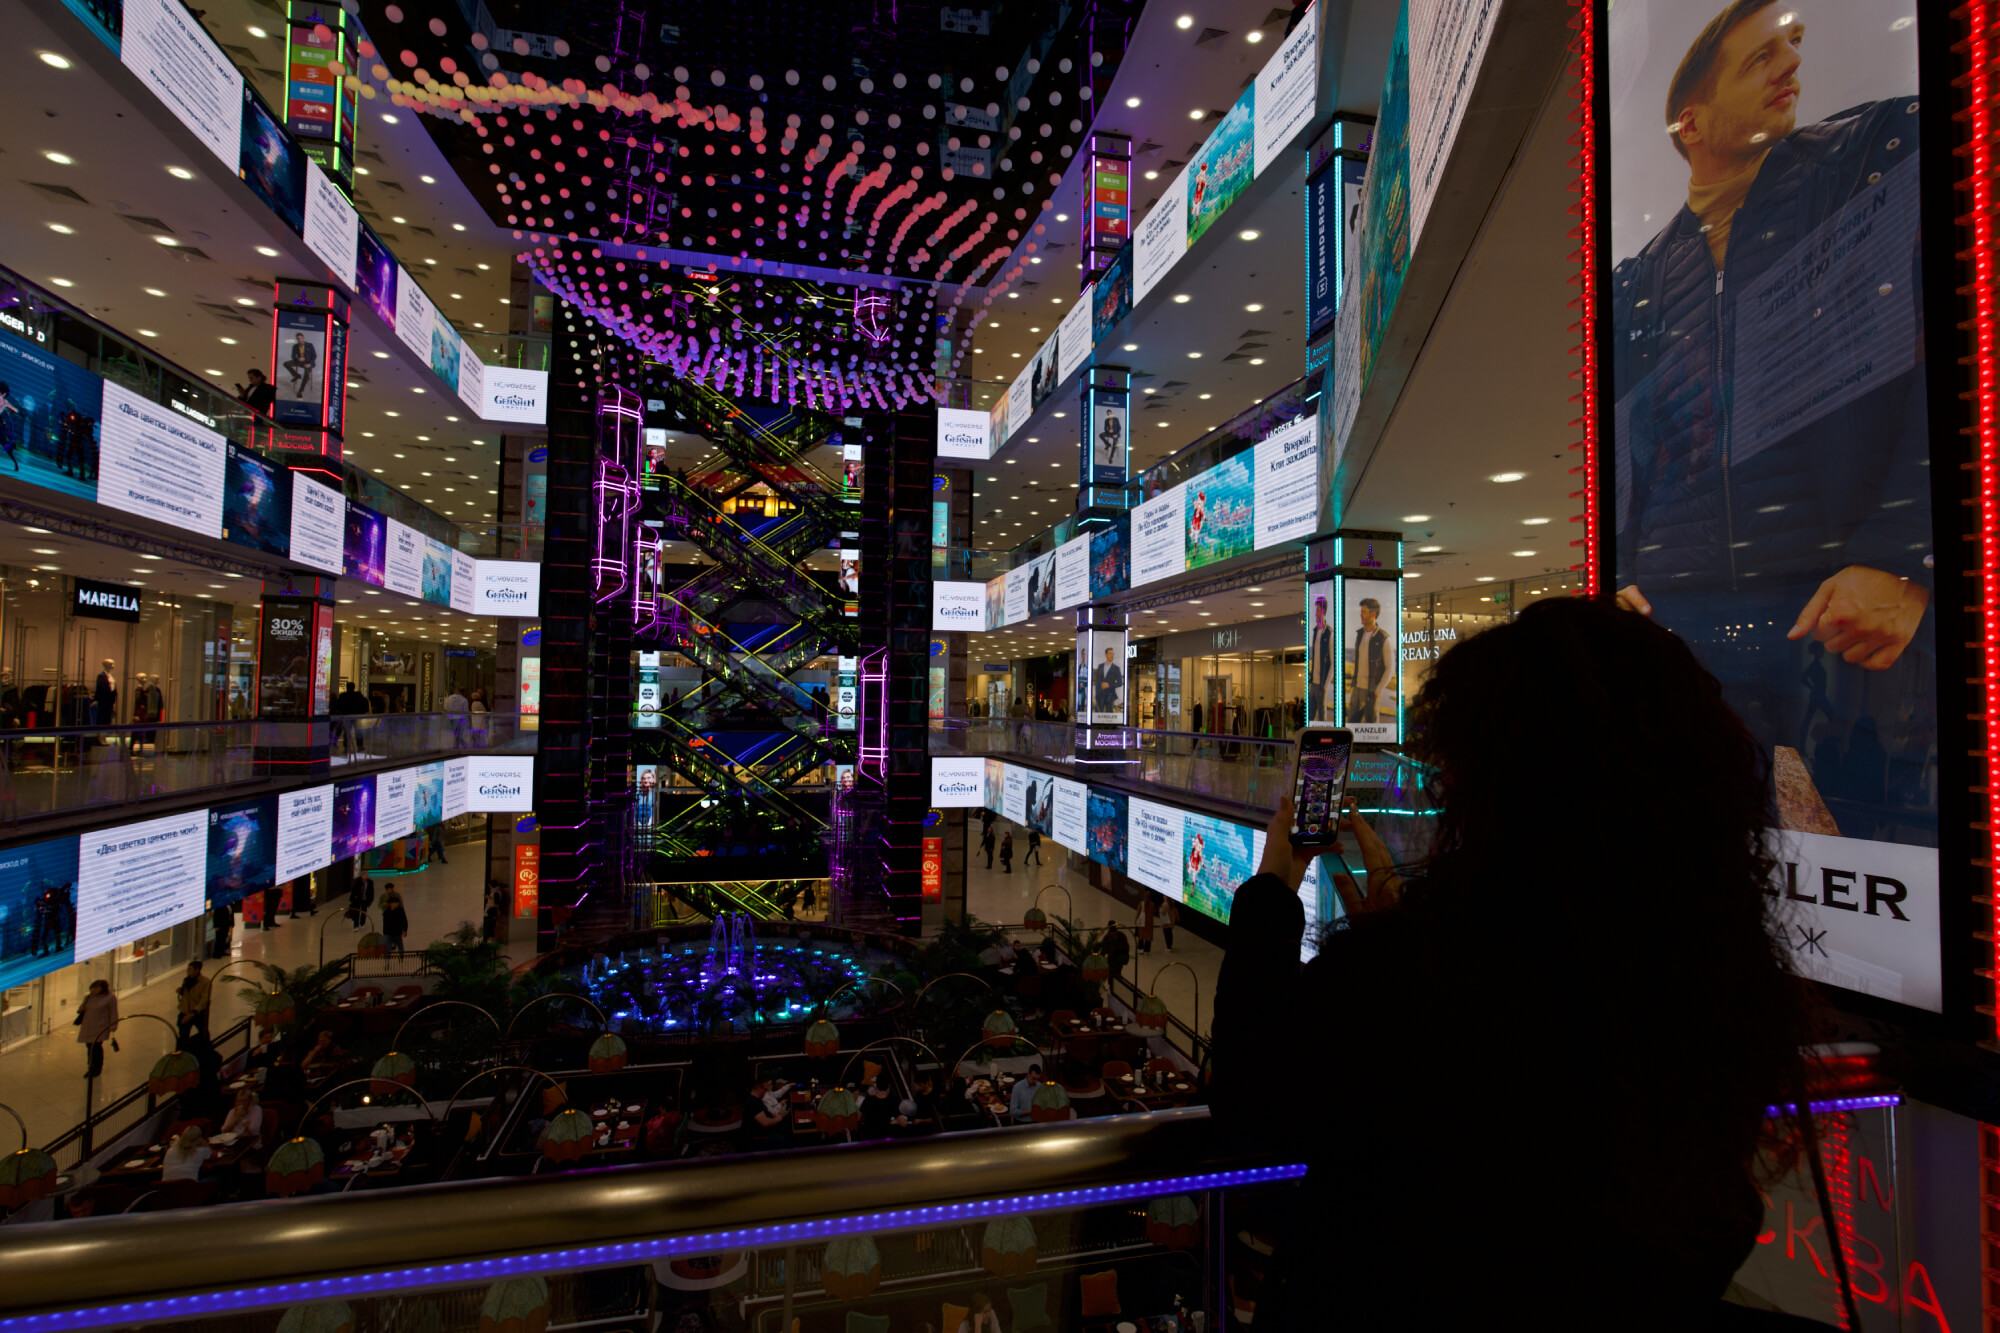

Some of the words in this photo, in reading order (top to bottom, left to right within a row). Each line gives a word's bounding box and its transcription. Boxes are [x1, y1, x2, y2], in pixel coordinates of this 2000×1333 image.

[1317, 182, 1325, 278] HENDERSON
[1266, 421, 1293, 441] LACOSTE
[1270, 459, 1284, 473] Кли
[79, 588, 140, 612] MARELLA
[486, 588, 528, 600] GENSHIN
[940, 606, 979, 617] GENSHIN
[271, 618, 304, 631] 30%
[270, 629, 304, 638] СКИДКА
[479, 784, 521, 796] GENSHIN
[939, 782, 977, 794] GENSHIN
[119, 837, 146, 851] цветка
[148, 829, 179, 845] цинсинь
